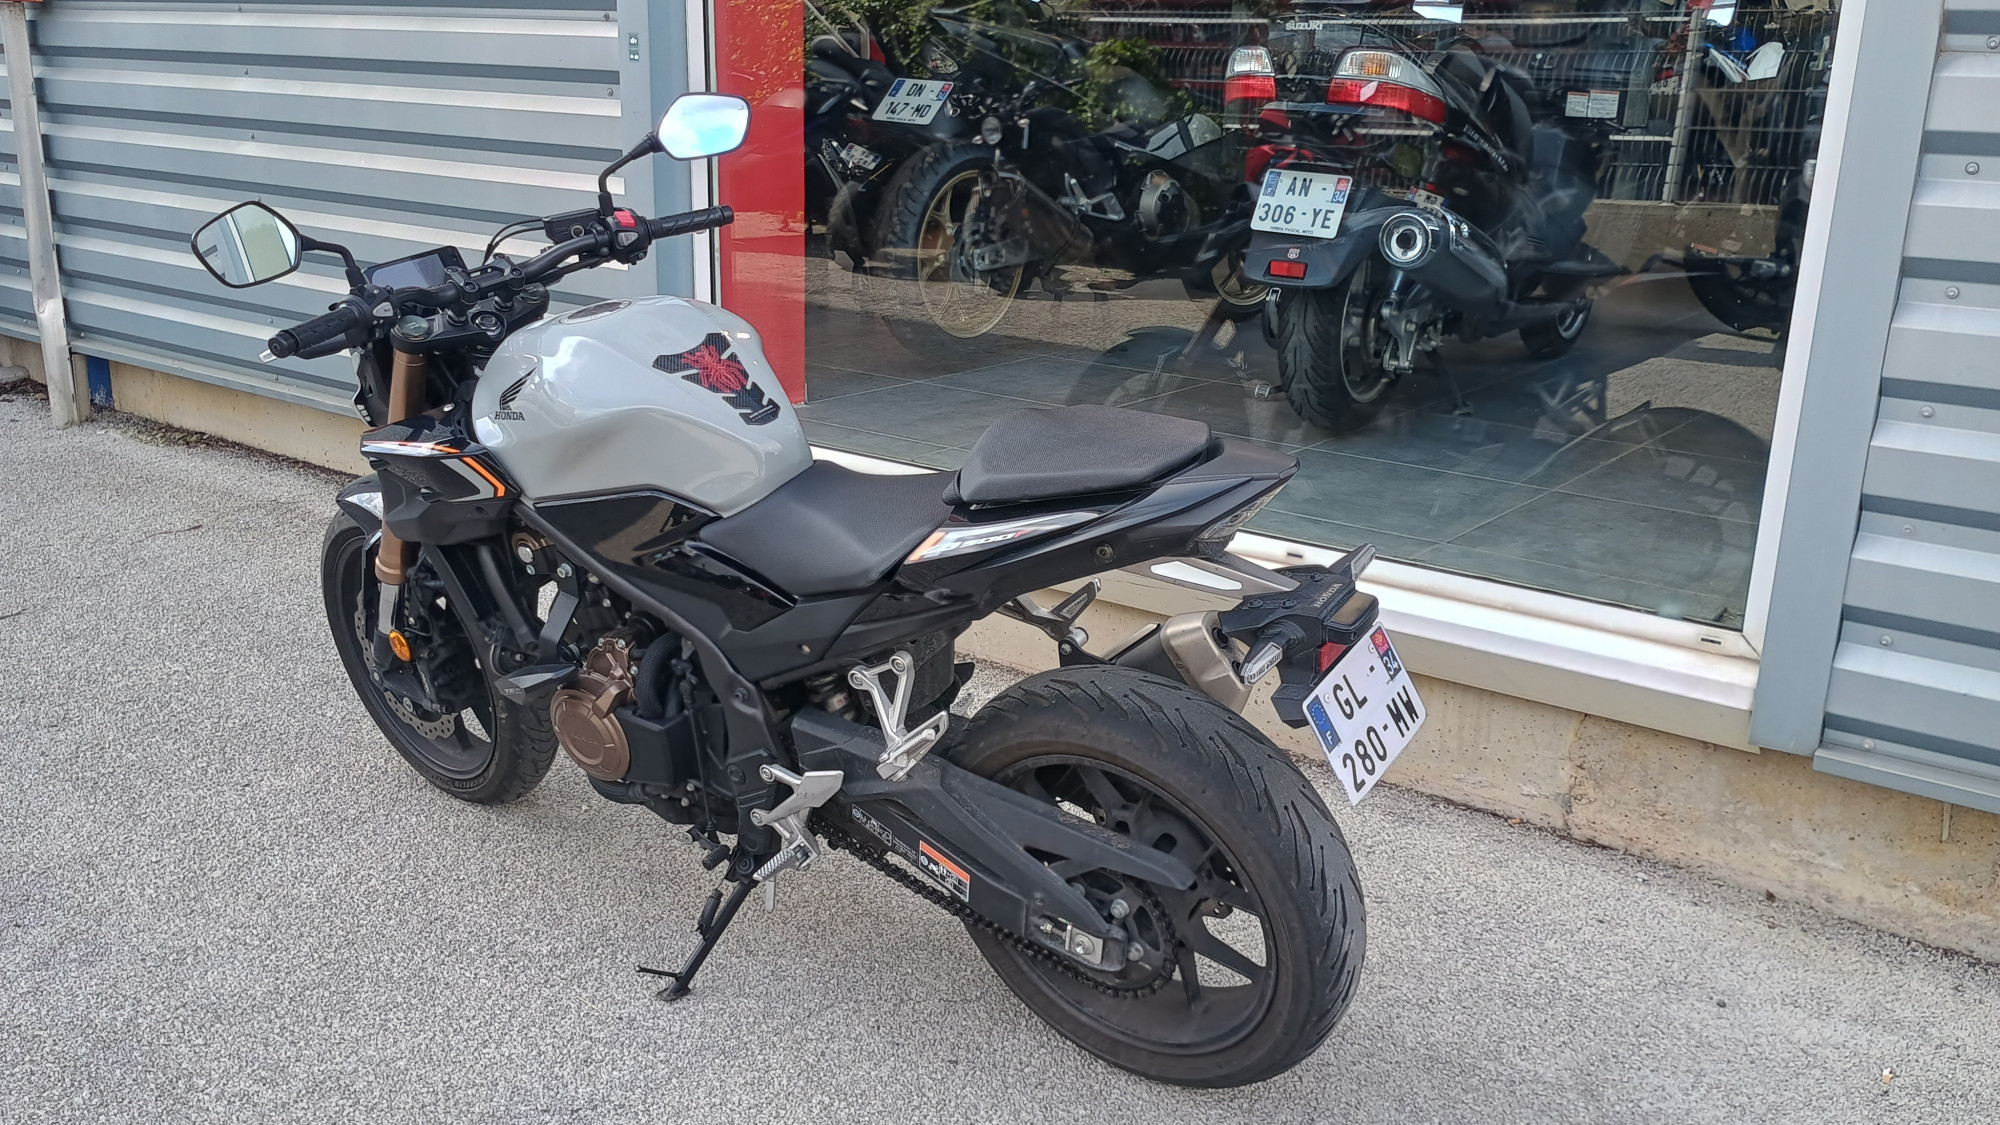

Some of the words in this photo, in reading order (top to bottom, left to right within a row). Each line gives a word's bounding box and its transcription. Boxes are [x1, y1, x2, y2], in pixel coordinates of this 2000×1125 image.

[1285, 21, 1323, 31] SUZUKI
[906, 83, 927, 98] DN
[1286, 177, 1313, 198] AN
[1332, 190, 1345, 203] 34
[1258, 202, 1336, 230] 306-YE
[494, 410, 526, 421] HONDA
[1311, 582, 1344, 609] HONDA
[1382, 650, 1400, 676] 34
[1332, 674, 1368, 721] GL
[1325, 730, 1334, 746] F
